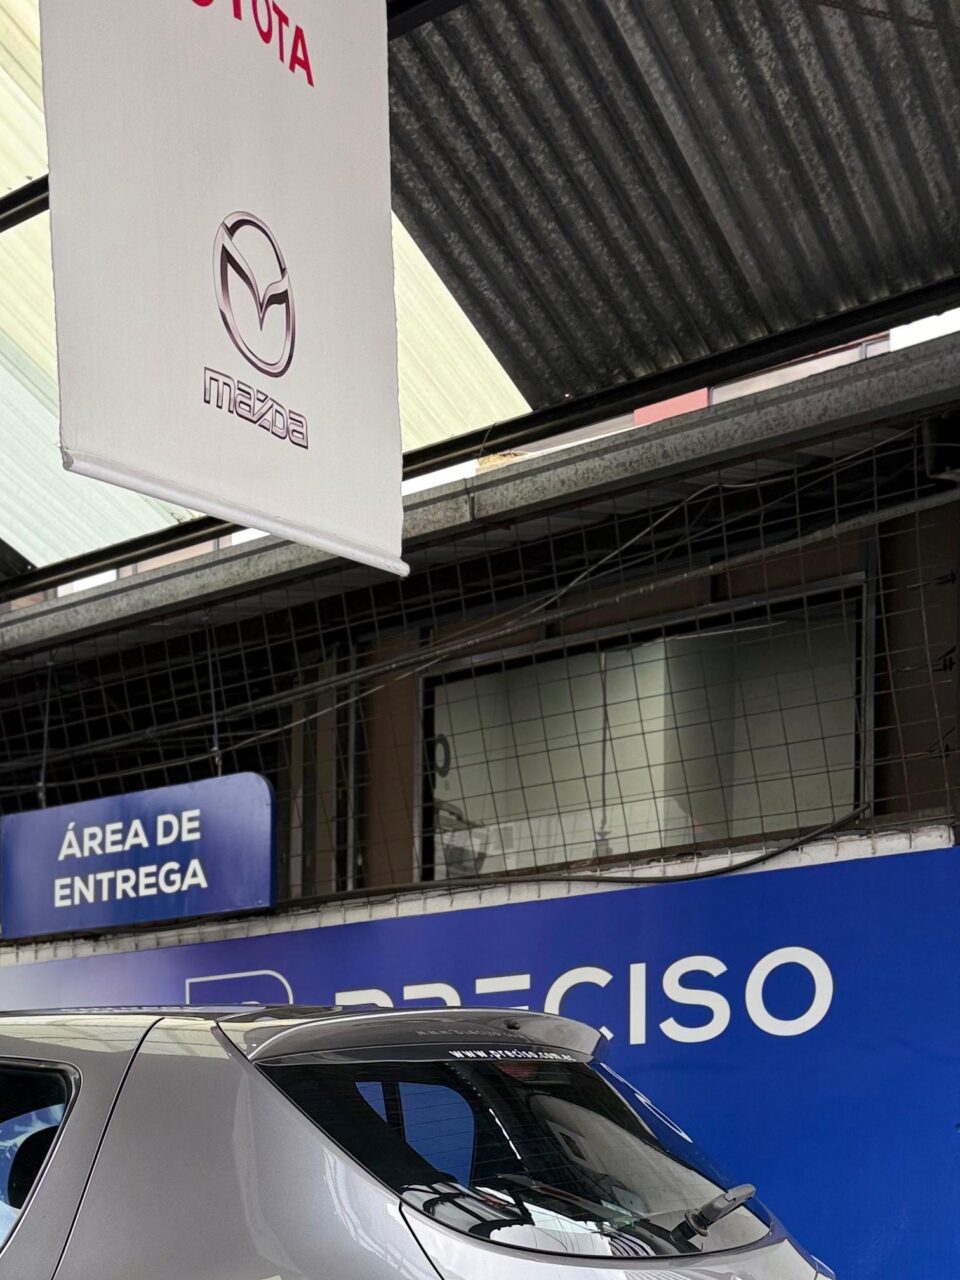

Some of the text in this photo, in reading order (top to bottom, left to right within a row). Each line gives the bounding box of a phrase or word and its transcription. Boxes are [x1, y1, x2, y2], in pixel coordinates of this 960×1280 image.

[191, 0, 315, 87] OTA
[203, 366, 308, 449] mazda
[58, 809, 201, 861] ÁREA DE
[53, 858, 208, 908] ENTREGA
